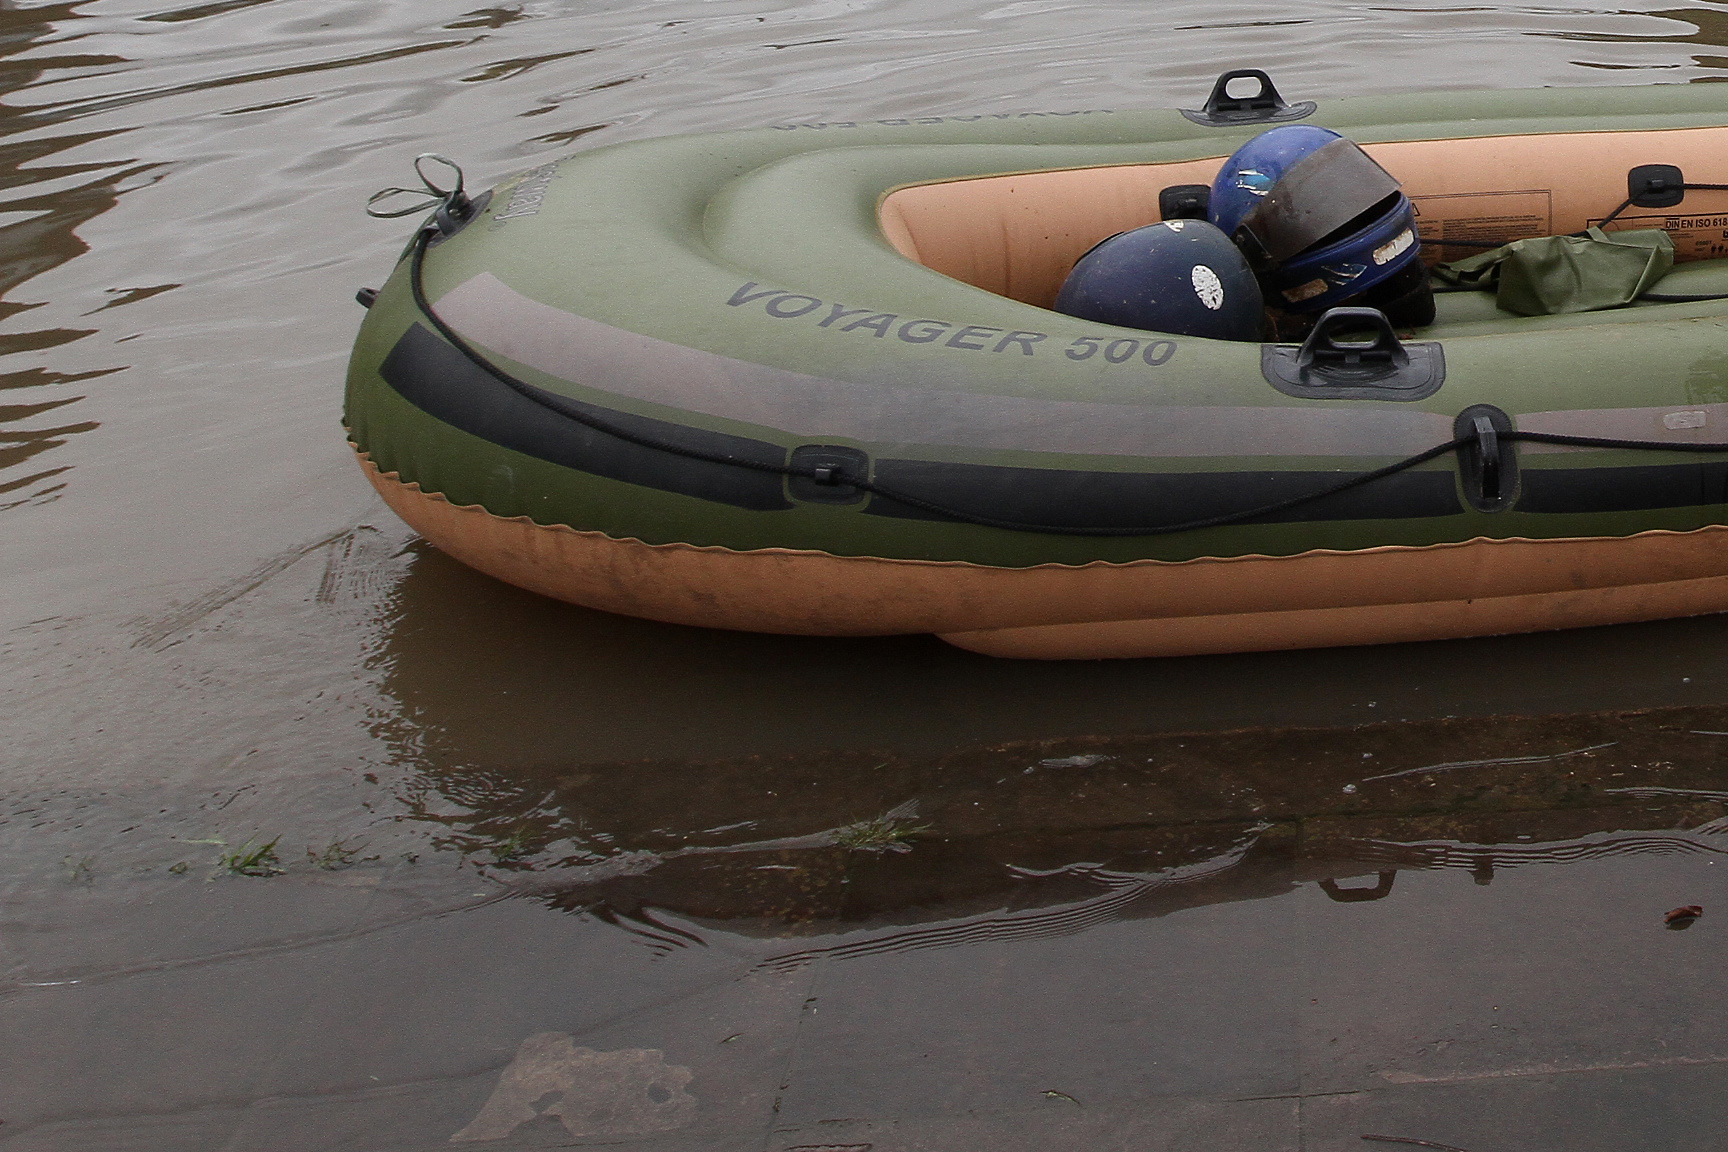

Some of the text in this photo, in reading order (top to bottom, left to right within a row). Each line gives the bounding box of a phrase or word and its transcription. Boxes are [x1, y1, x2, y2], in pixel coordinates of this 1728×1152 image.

[1665, 219, 1680, 229] DIN
[1681, 219, 1694, 228] EN
[1695, 218, 1711, 228] ISO
[727, 282, 1178, 366] VOYAGER 500
